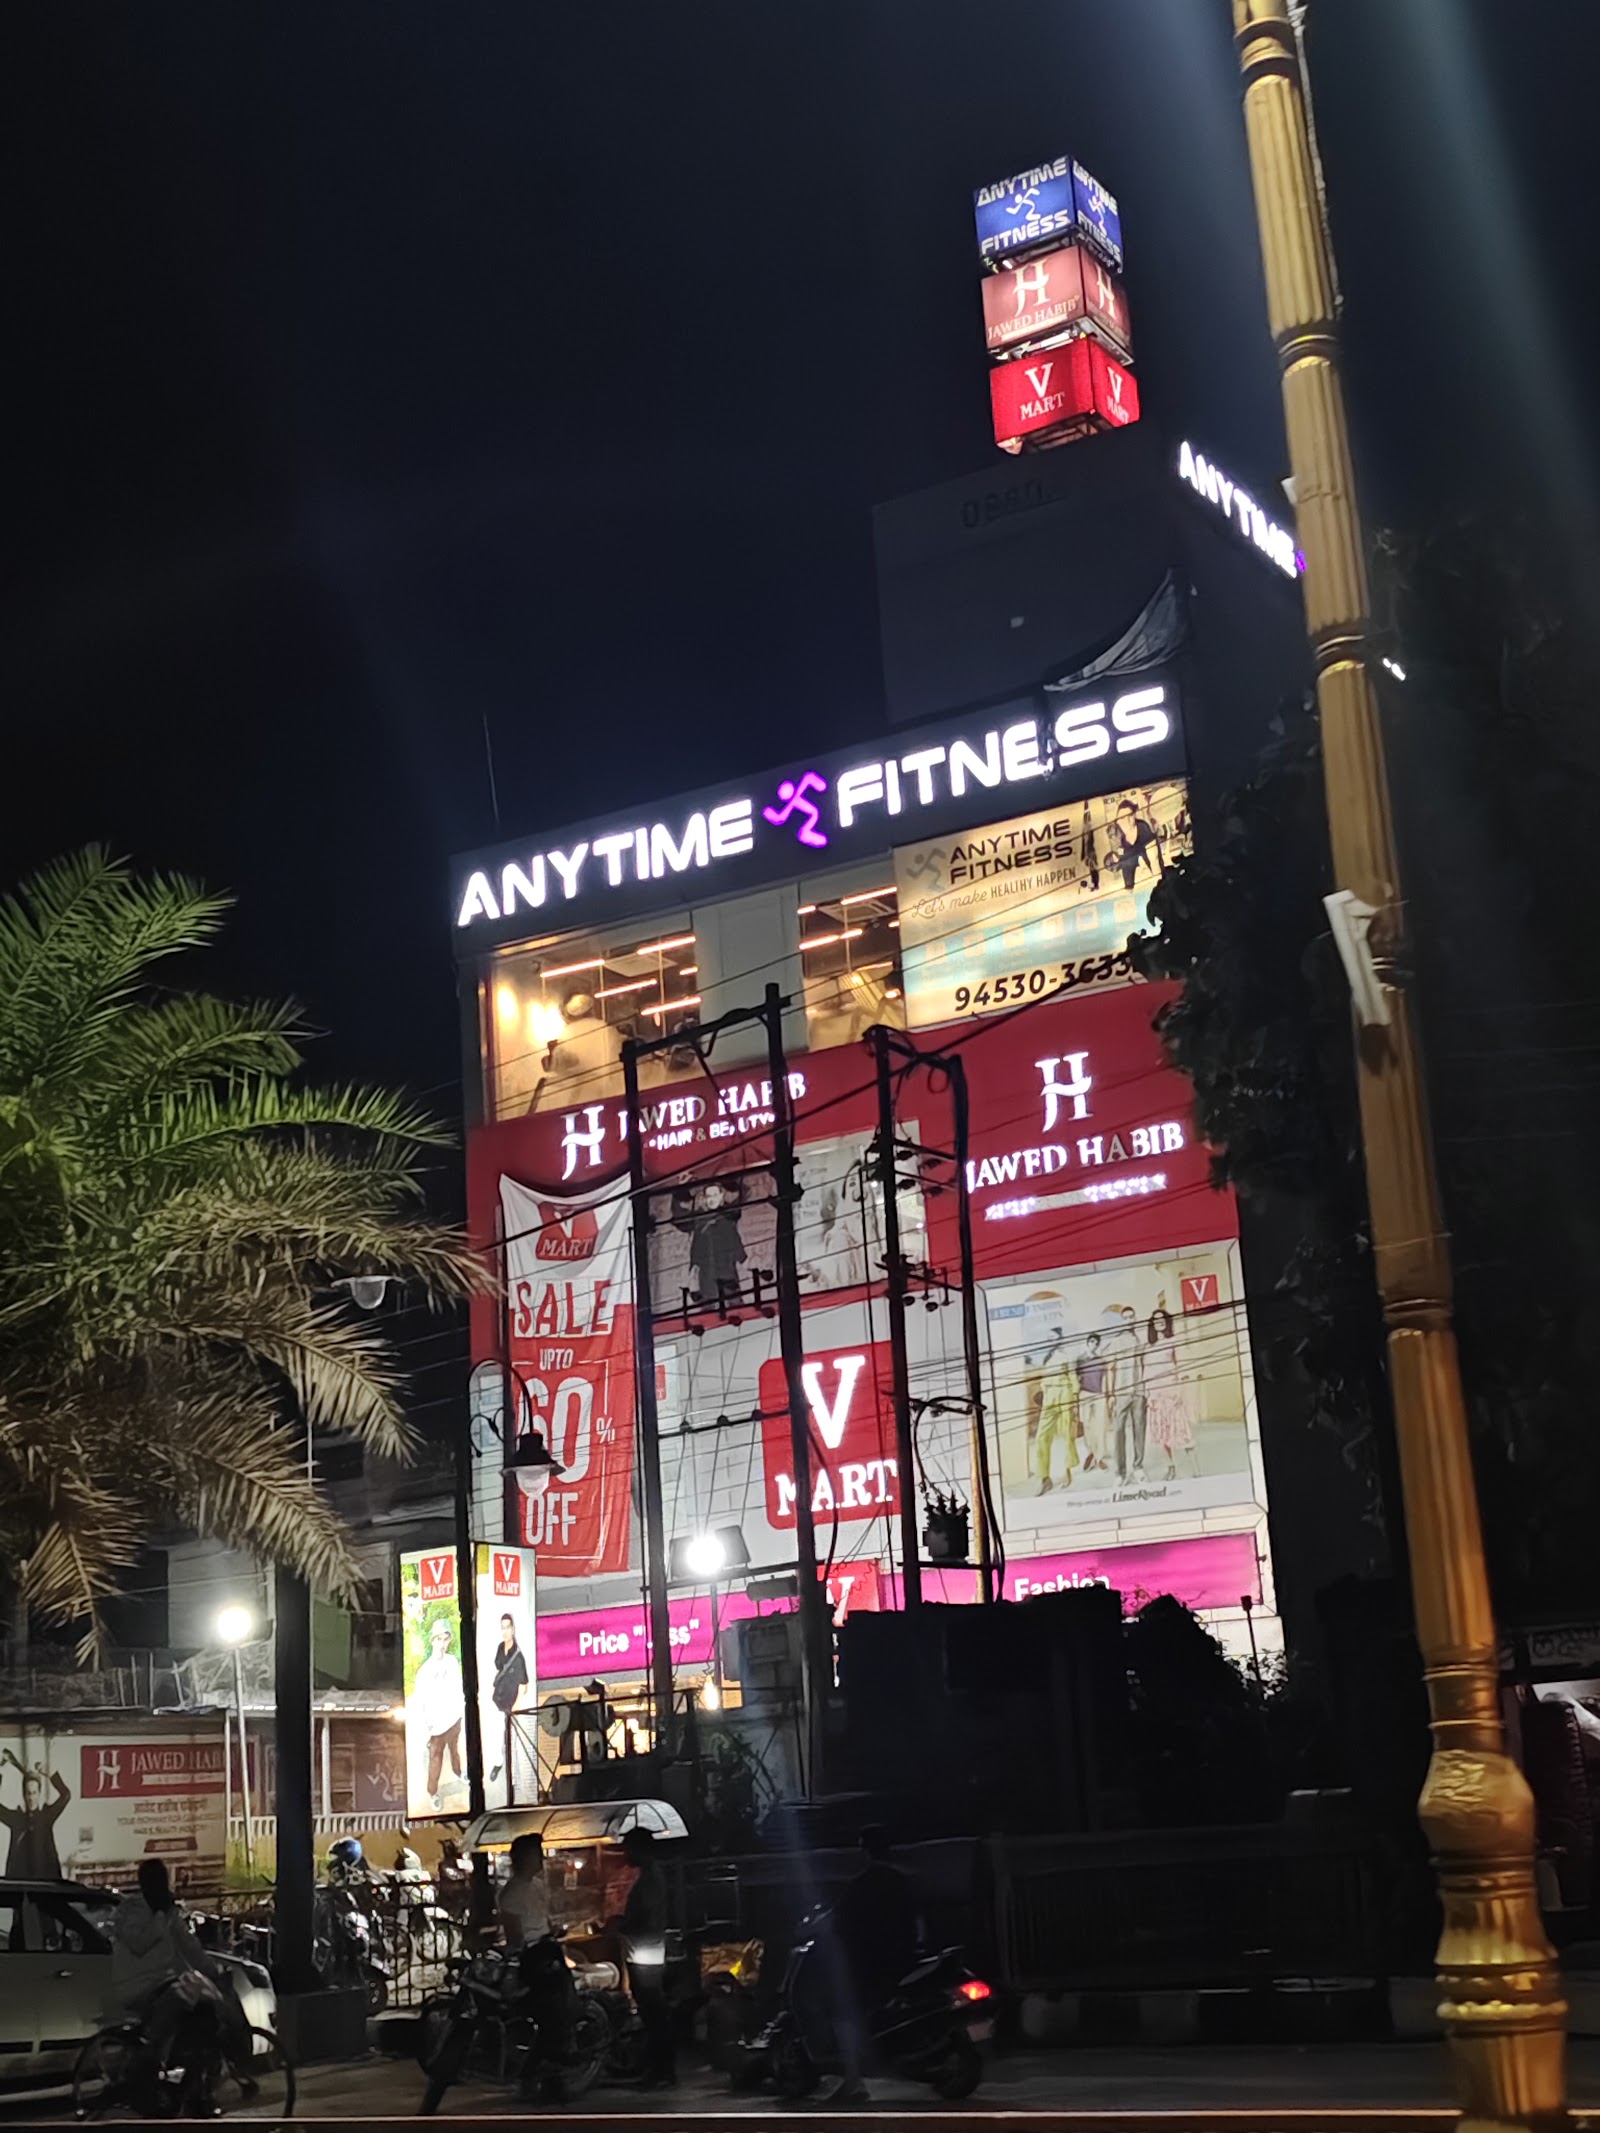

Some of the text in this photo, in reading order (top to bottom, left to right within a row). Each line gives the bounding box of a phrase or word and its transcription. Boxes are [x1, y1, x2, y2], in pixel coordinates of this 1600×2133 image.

[977, 156, 1067, 206] ANYTIME
[981, 209, 1070, 255] FITNESS
[988, 314, 1032, 341] JAWED
[1034, 299, 1077, 324] HABIB
[1024, 362, 1054, 398] V
[1020, 392, 1066, 420] MART
[457, 686, 1169, 926] ANYTIME FITNESS
[950, 818, 1072, 865] ANYTIME
[950, 840, 1074, 885] FITNESS
[949, 889, 988, 908] make
[991, 878, 1033, 899] HEALTHY
[1036, 866, 1077, 890] HAPPEN
[617, 1095, 707, 1142] JWED
[717, 1072, 807, 1117] HABB
[657, 1128, 693, 1151] HAIR
[965, 1121, 1185, 1194] JAWED HABIB
[540, 1238, 594, 1258] MART
[516, 1279, 613, 1335] SALE
[540, 1348, 574, 1371] UPTO
[800, 1355, 866, 1450] V
[526, 1491, 579, 1546] OFF
[427, 1558, 447, 1585] V
[495, 1581, 520, 1595] MART
[499, 1556, 515, 1582] V
[423, 1583, 453, 1599] MART
[579, 1628, 630, 1657] Price
[131, 1751, 185, 1775] JAWED
